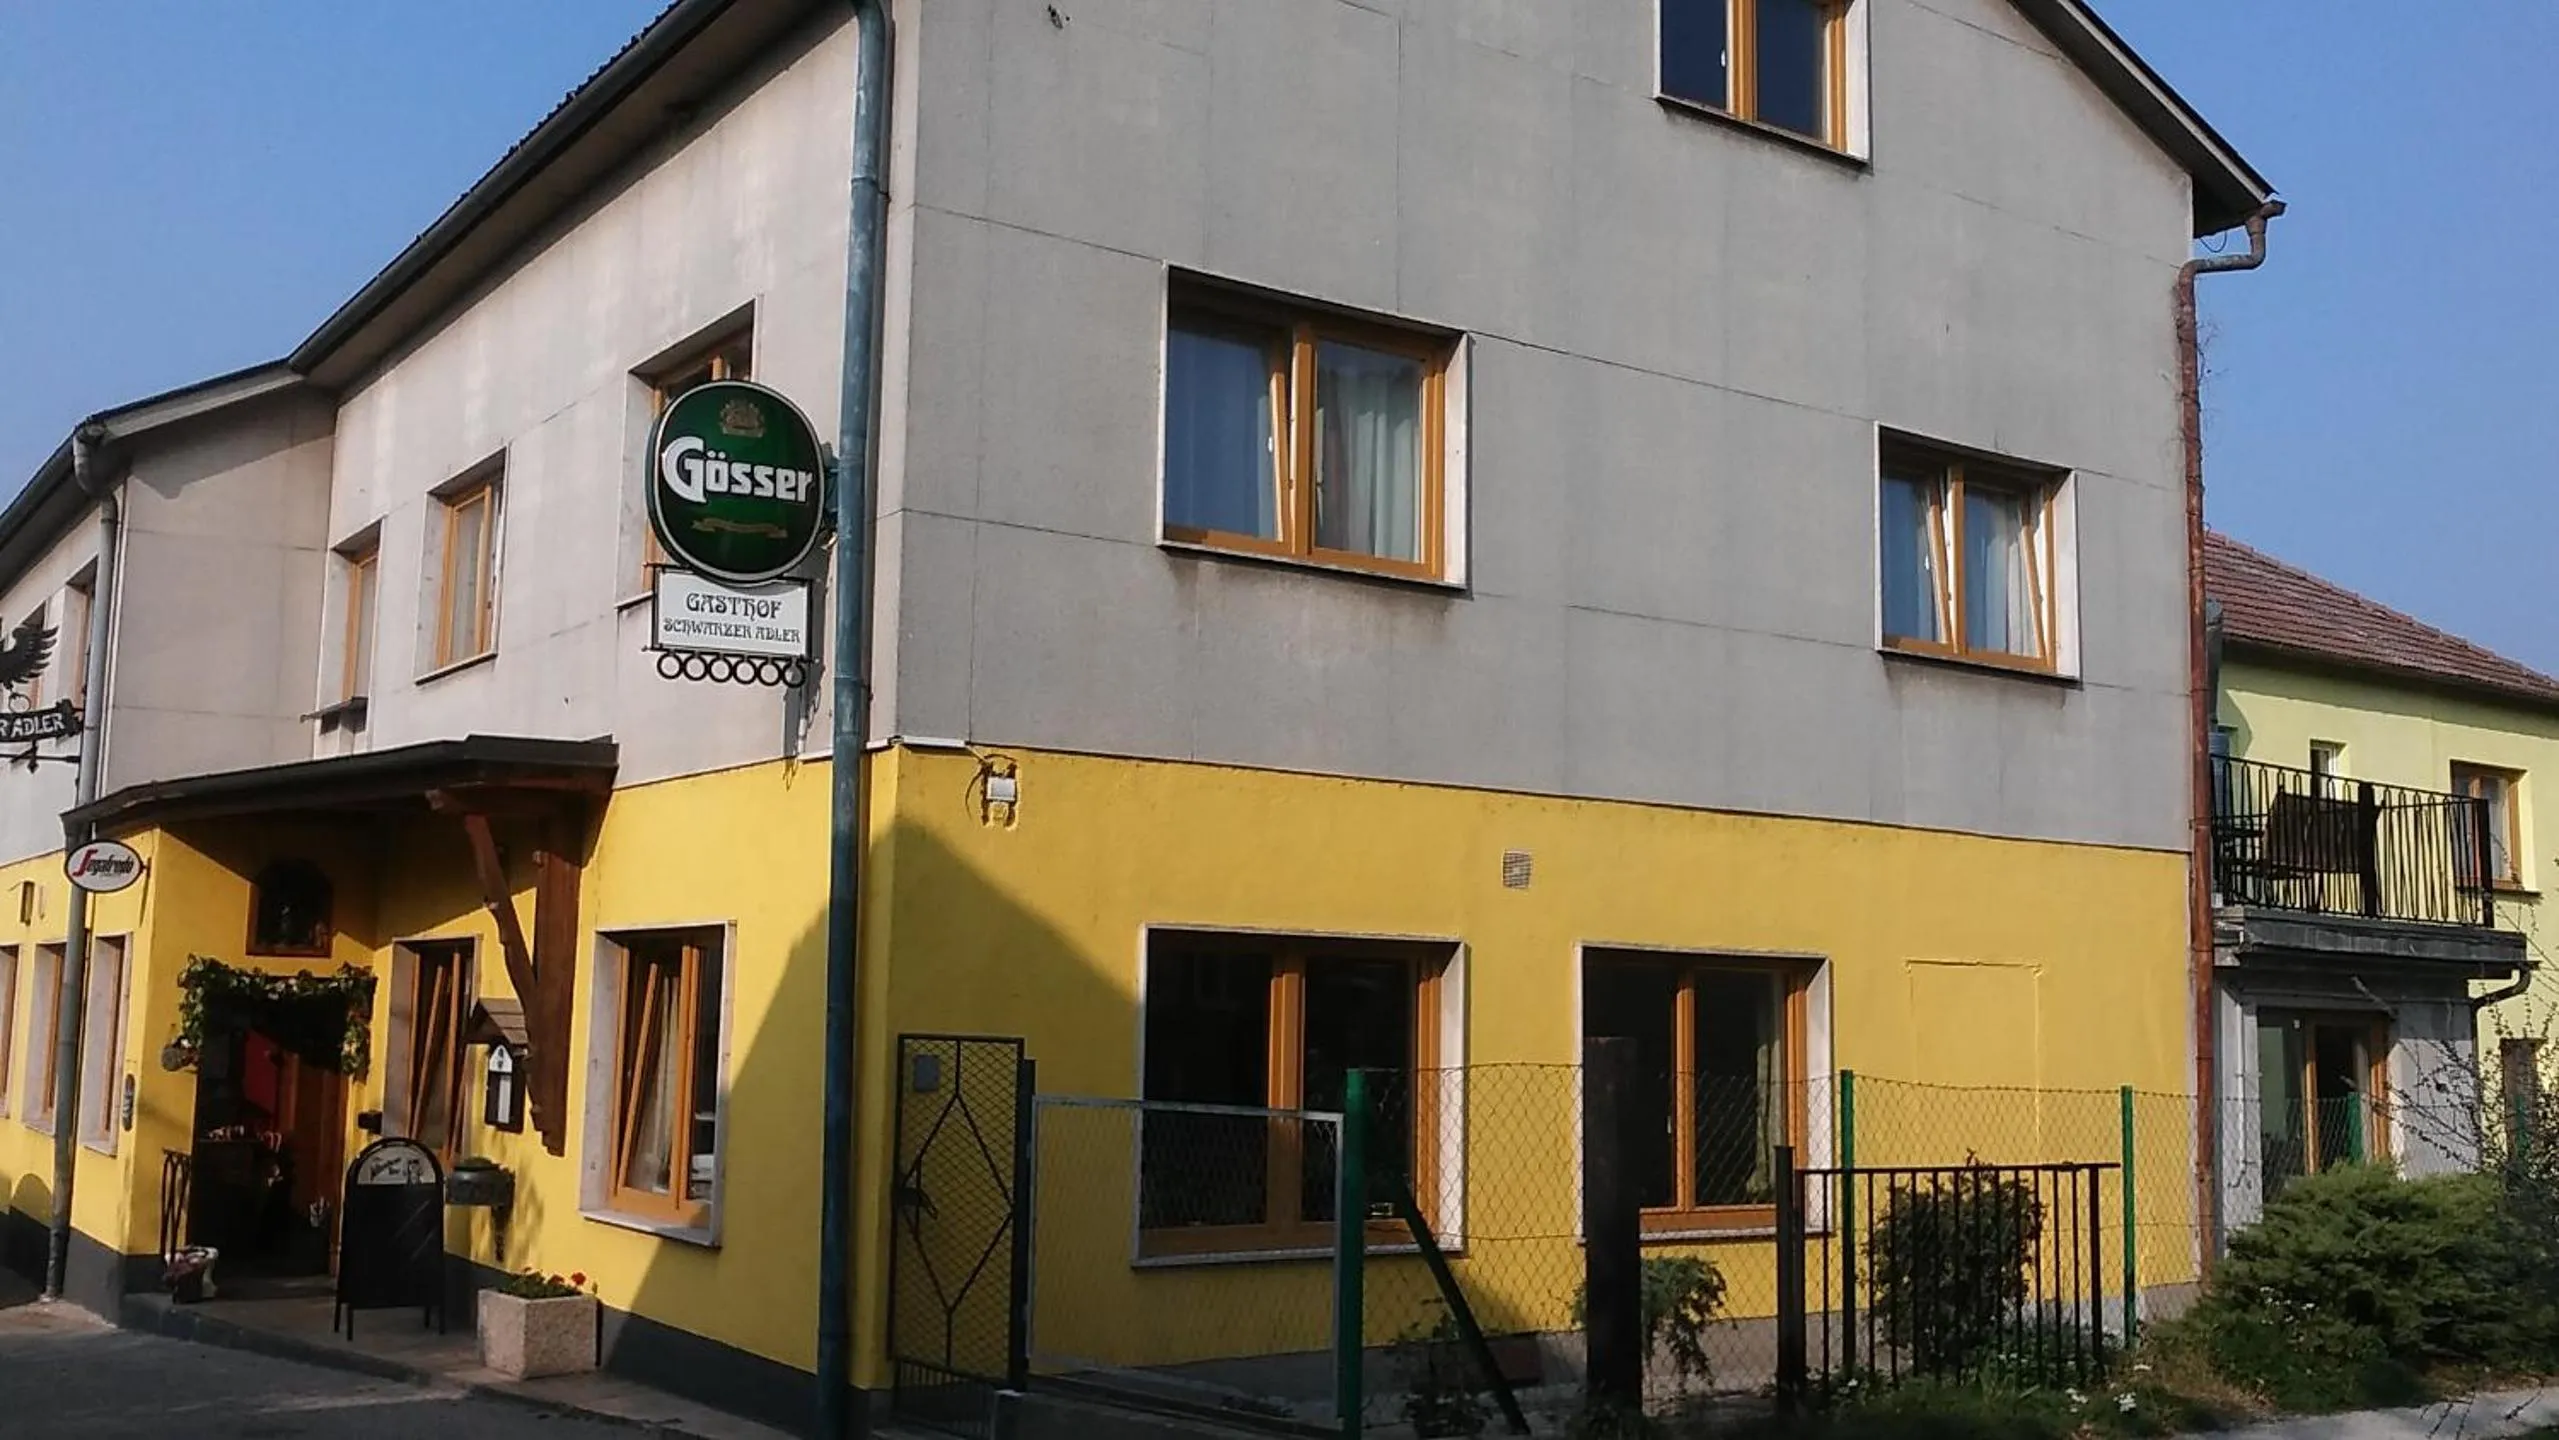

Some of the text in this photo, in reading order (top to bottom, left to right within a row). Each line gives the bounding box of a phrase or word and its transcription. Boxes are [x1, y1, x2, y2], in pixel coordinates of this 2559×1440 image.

[661, 436, 813, 503] Gösser
[686, 592, 782, 620] GASTHOF
[663, 617, 801, 643] SCHWARZER ADLER
[10, 713, 65, 738] ADLER
